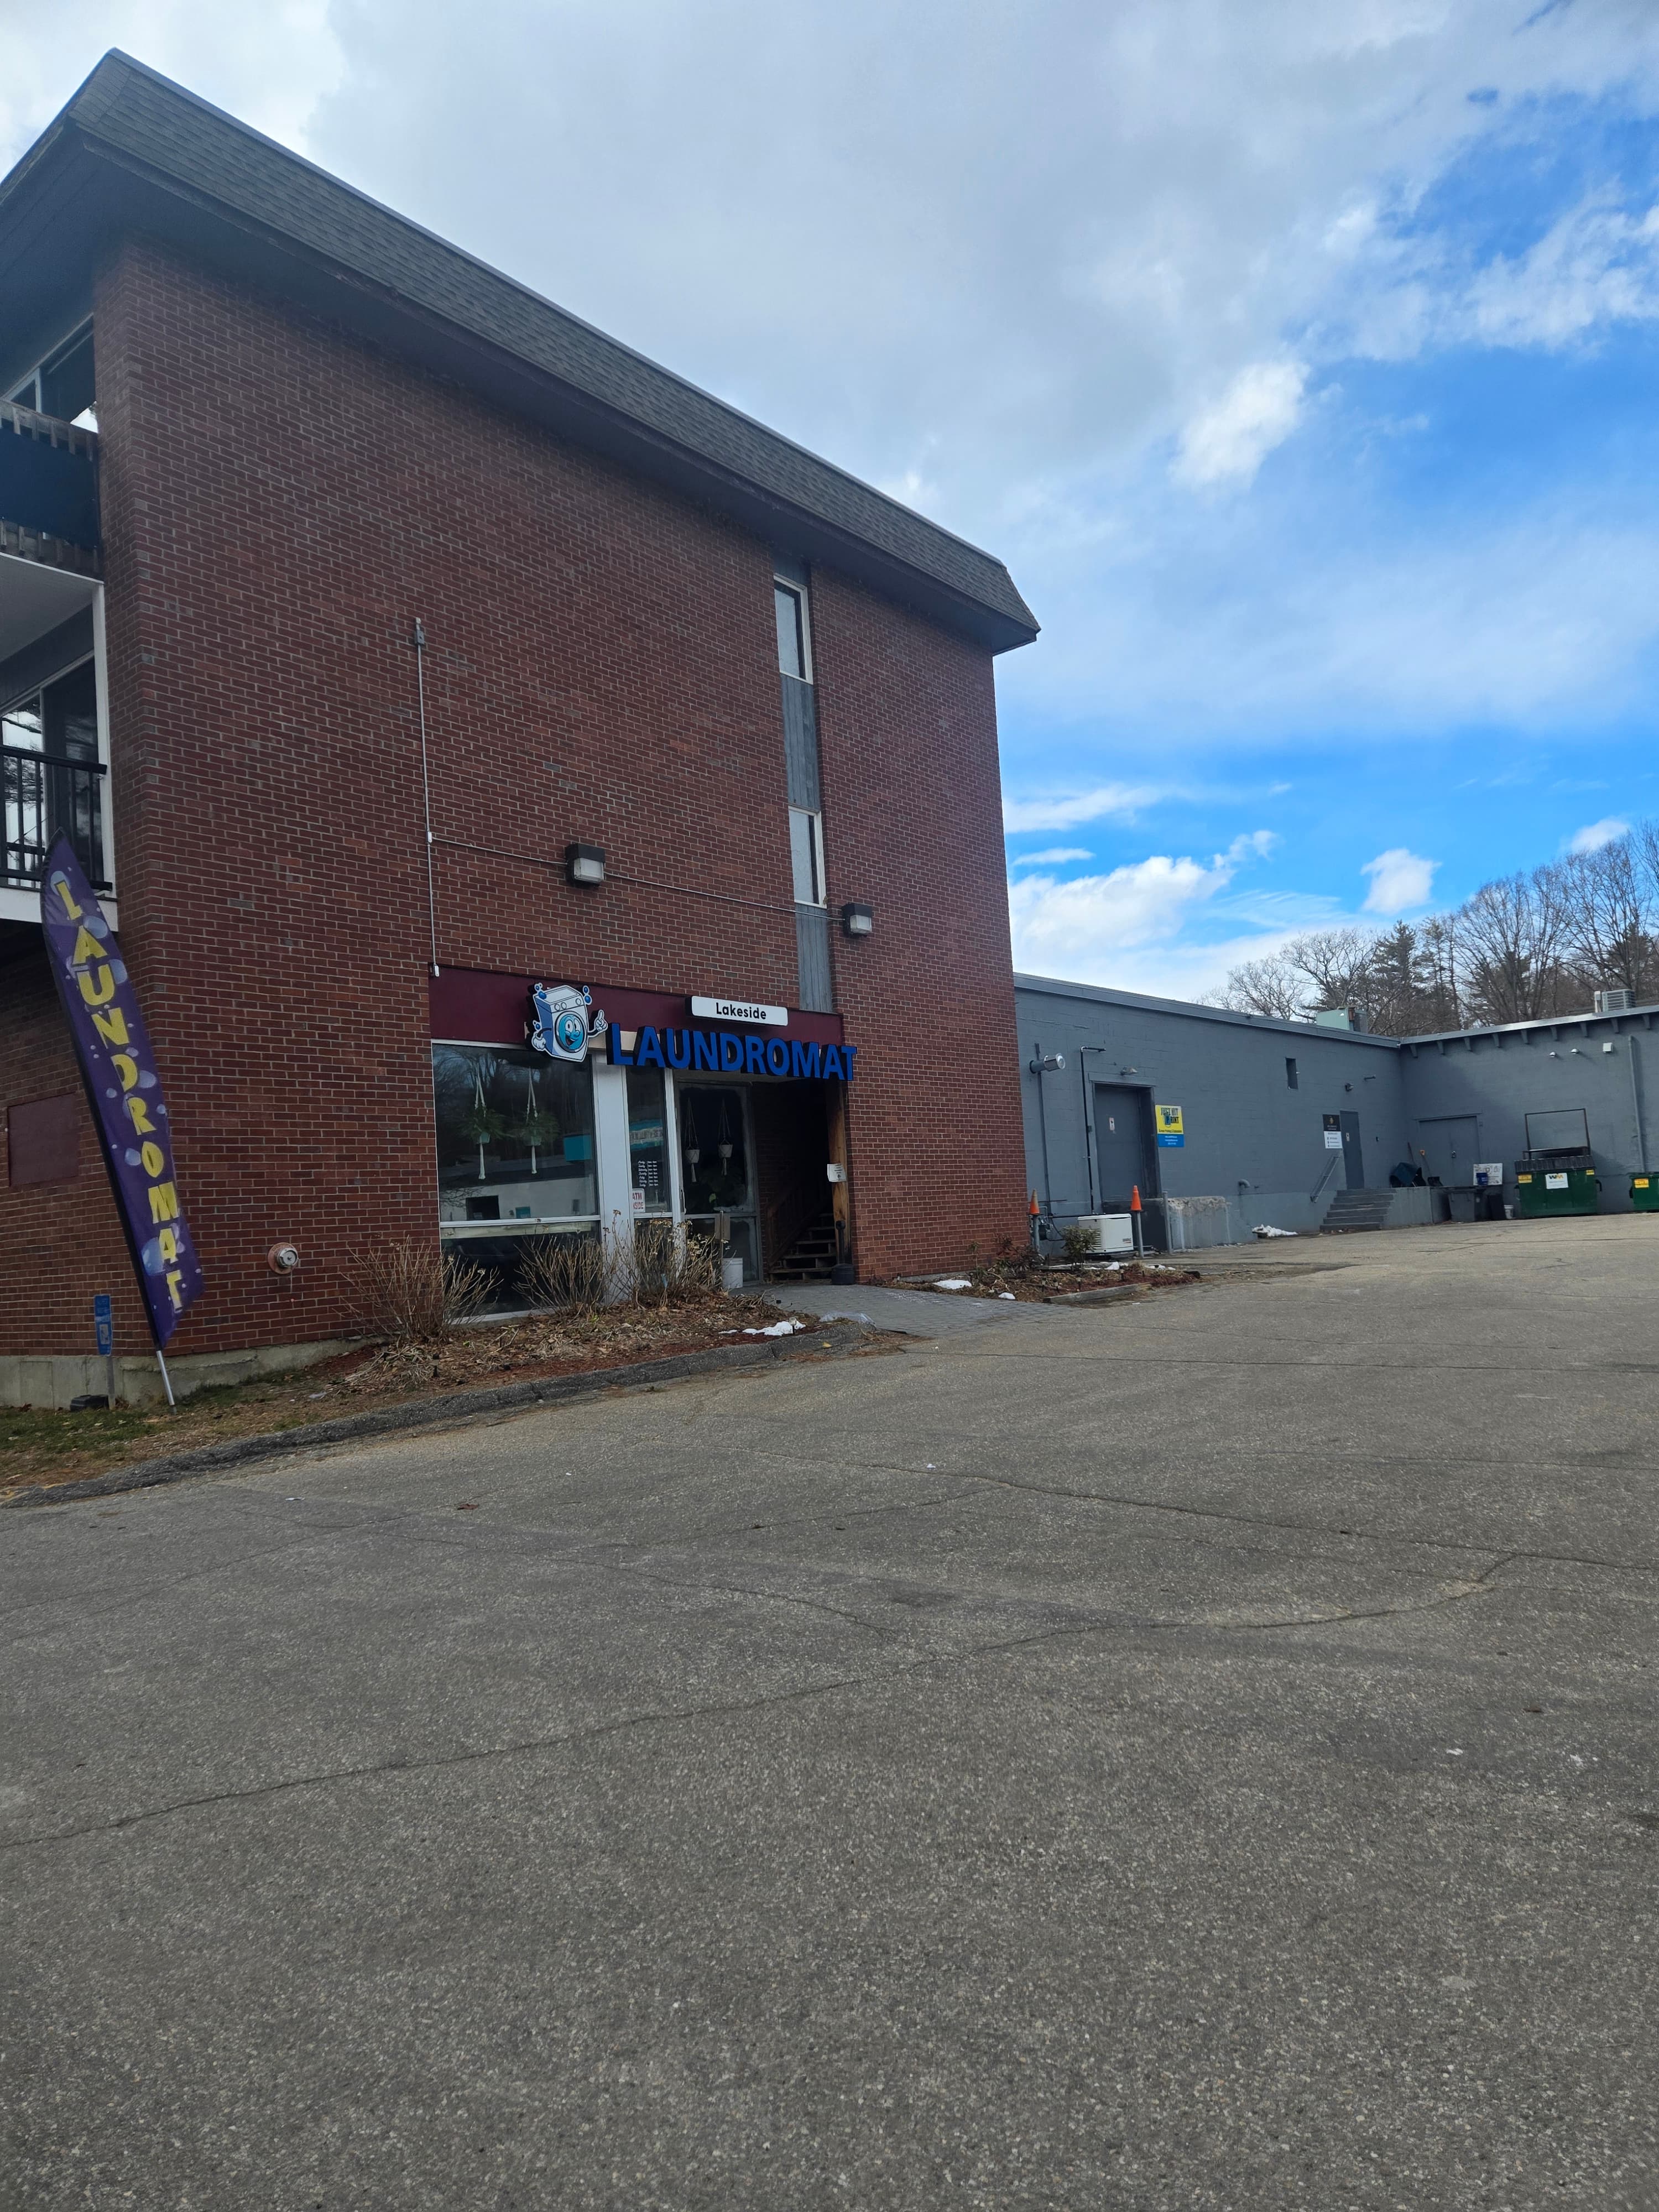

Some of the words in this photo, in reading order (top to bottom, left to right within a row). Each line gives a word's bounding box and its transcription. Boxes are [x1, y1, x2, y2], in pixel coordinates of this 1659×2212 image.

[716, 1002, 767, 1020] Lakeside
[609, 1022, 857, 1081] LAUNDROMAT
[56, 879, 182, 1311] LAUNDROMAT
